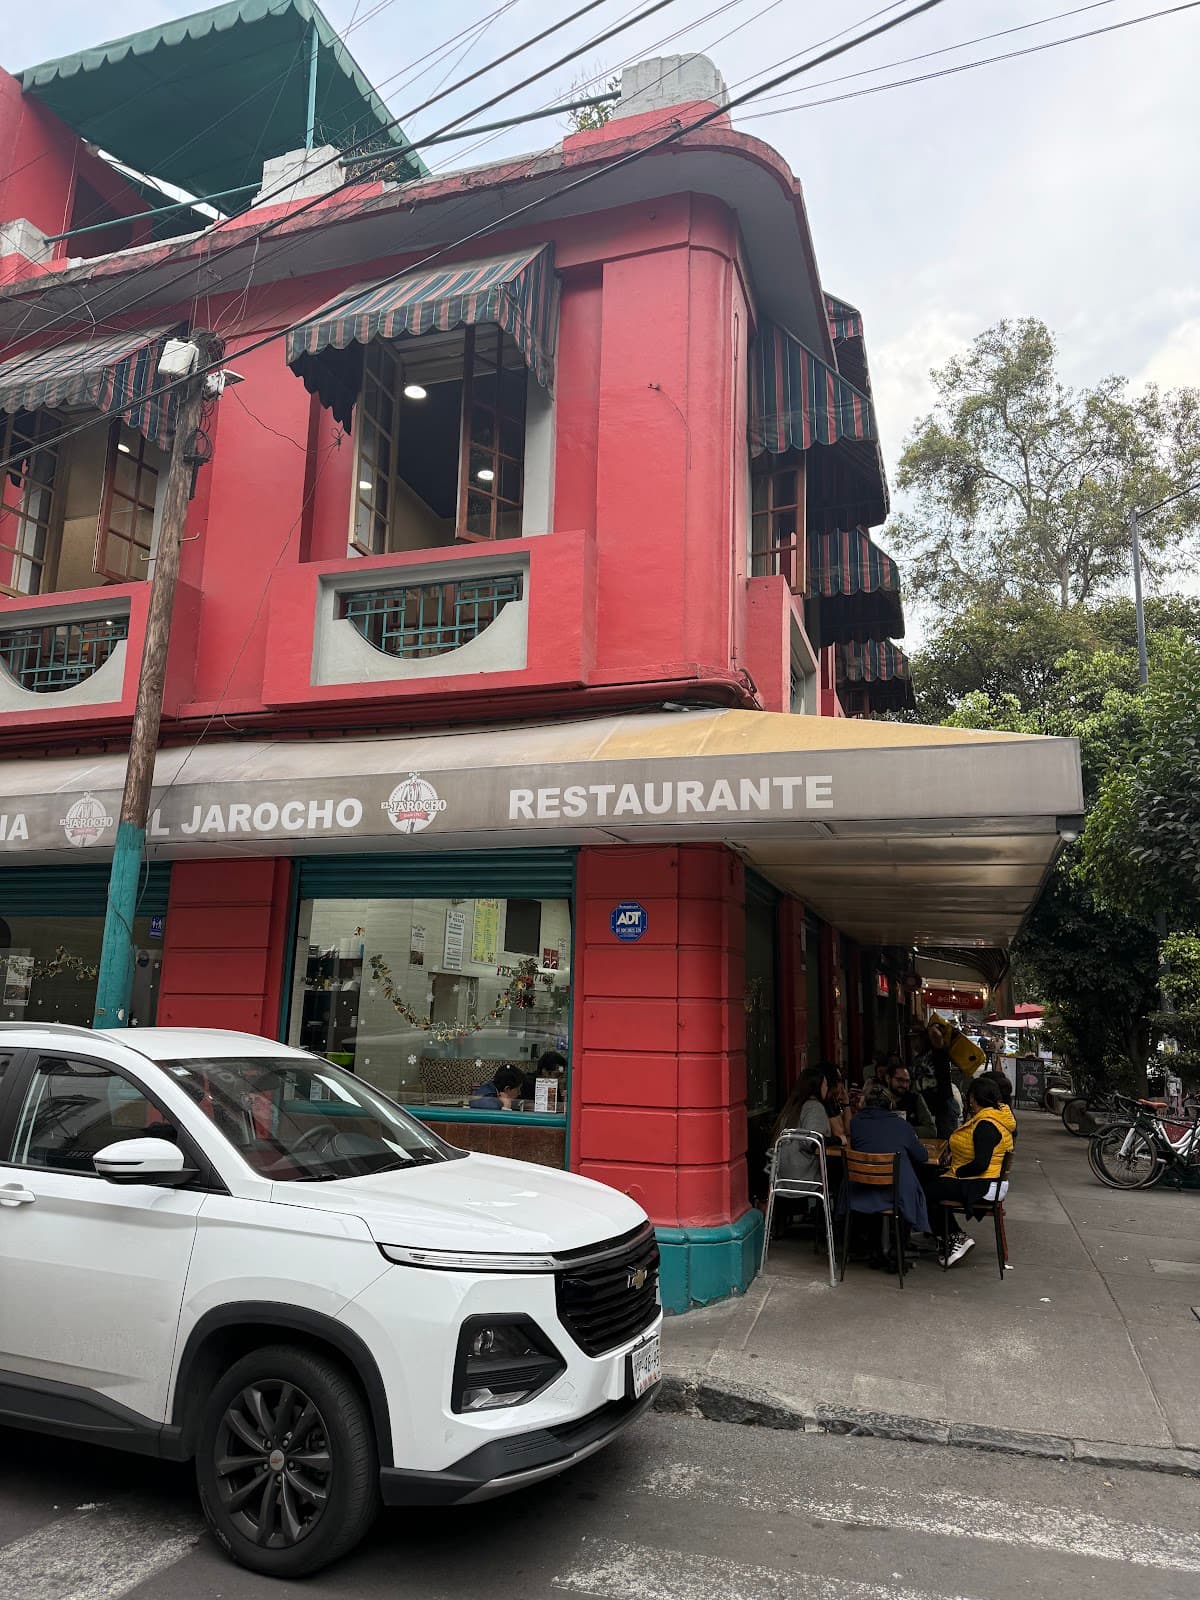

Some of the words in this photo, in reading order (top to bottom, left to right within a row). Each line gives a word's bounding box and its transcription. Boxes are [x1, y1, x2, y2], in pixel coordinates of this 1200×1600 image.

[508, 775, 834, 820] RESTAURANTE
[389, 799, 448, 812] JAROCHO
[66, 816, 114, 829] JAROCHO
[181, 798, 363, 834] JAROCHO
[616, 911, 642, 925] ADT
